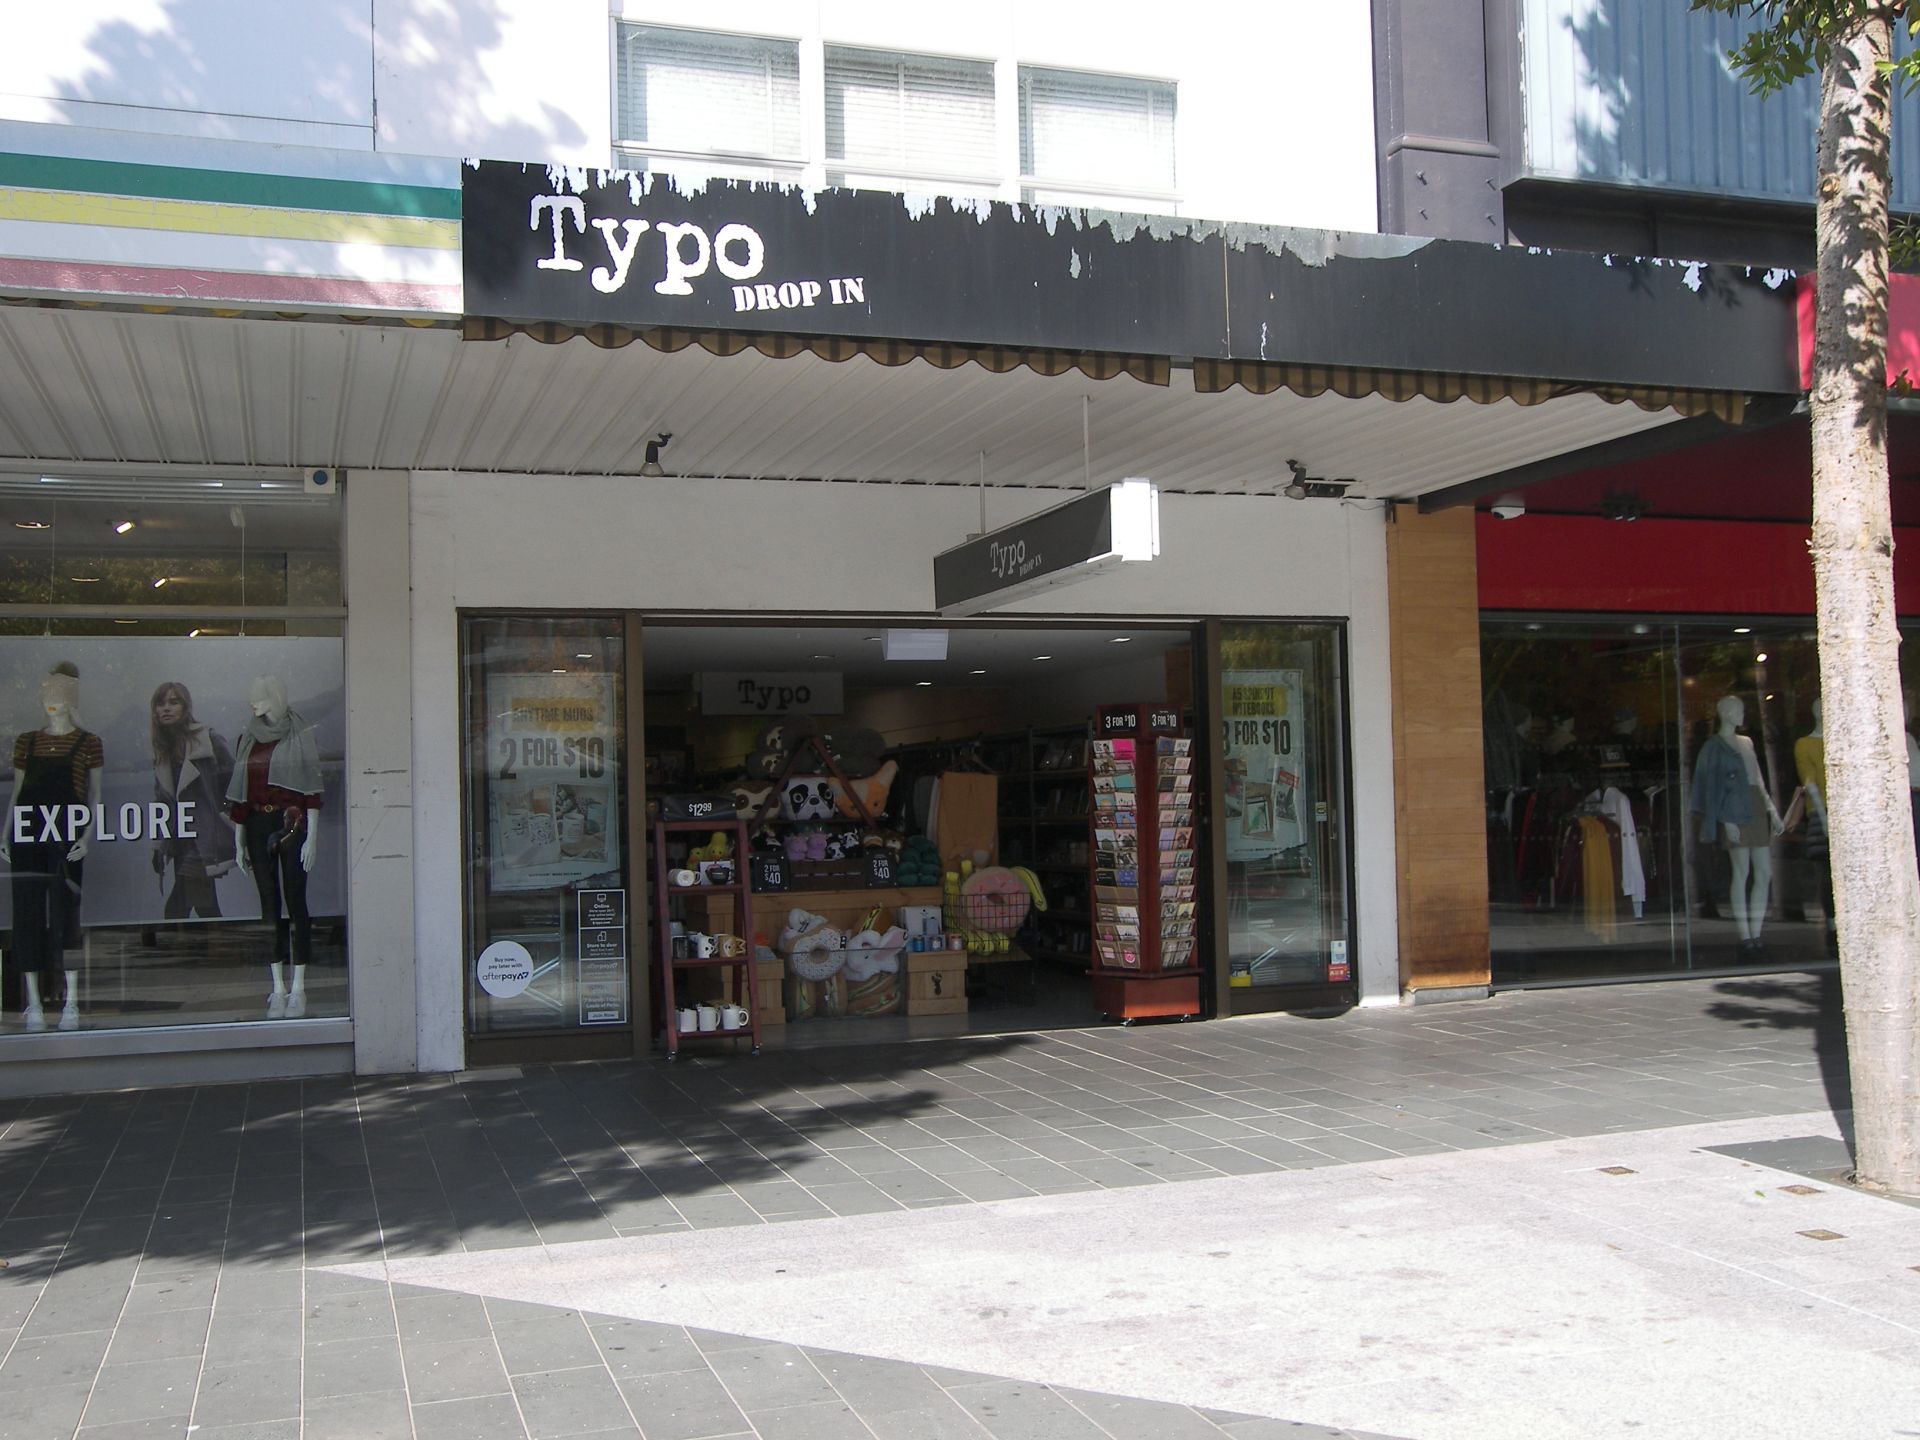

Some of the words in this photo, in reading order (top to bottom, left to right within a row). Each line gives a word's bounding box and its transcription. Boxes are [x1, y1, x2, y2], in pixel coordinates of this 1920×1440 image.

[530, 195, 765, 296] Typo
[732, 280, 821, 312] DROP
[828, 277, 866, 305] IN
[990, 540, 1025, 578] Typo
[1019, 558, 1035, 577] DROP
[1035, 553, 1042, 567] IN
[738, 680, 811, 711] Typo
[1105, 716, 1111, 728] 3
[1112, 716, 1124, 727] FOR
[1124, 714, 1136, 728] $10
[1152, 714, 1157, 727] 3
[1157, 715, 1167, 725] FOR
[1167, 714, 1177, 727] $10
[1234, 720, 1259, 745] FOR
[1262, 720, 1291, 755] $10
[500, 737, 517, 779] 2
[522, 737, 559, 767] FOR
[563, 736, 605, 779] $10
[13, 801, 198, 844] EXPLORE
[764, 864, 769, 873] 2
[769, 864, 780, 872] FOR
[873, 859, 878, 868] 2
[878, 859, 889, 867] FOR
[874, 867, 890, 879] $40
[765, 872, 781, 885] $40
[482, 971, 518, 982] afterpay
